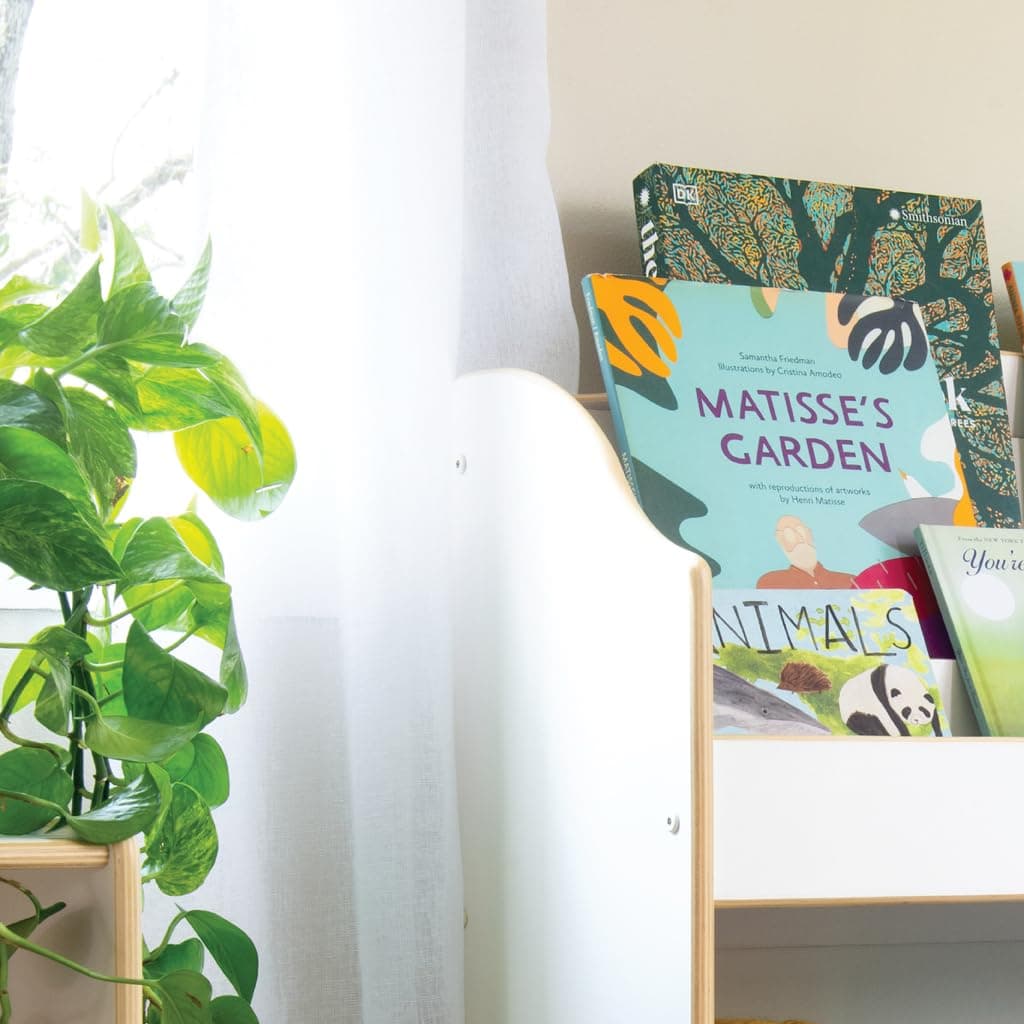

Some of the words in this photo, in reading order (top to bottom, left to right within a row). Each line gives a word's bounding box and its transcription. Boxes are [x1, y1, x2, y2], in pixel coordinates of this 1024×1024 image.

[676, 187, 695, 201] DK
[901, 209, 967, 227] Smithsonian
[738, 352, 778, 363] Samantha
[779, 355, 816, 365] Friedman
[718, 363, 763, 374] Illustrations
[765, 366, 776, 376] by
[776, 367, 807, 377] Cristina
[809, 369, 842, 379] Amodeo
[695, 387, 894, 429] MATISSE'S
[951, 418, 976, 428] REES
[720, 433, 892, 473] GARDEN
[749, 481, 767, 490] with
[768, 483, 823, 495] reproductions
[825, 486, 834, 494] of
[835, 487, 871, 496] artworks
[779, 494, 790, 505] by
[791, 495, 814, 504] Henri
[815, 496, 845, 506] Matisse
[713, 601, 912, 656] NIMALS
